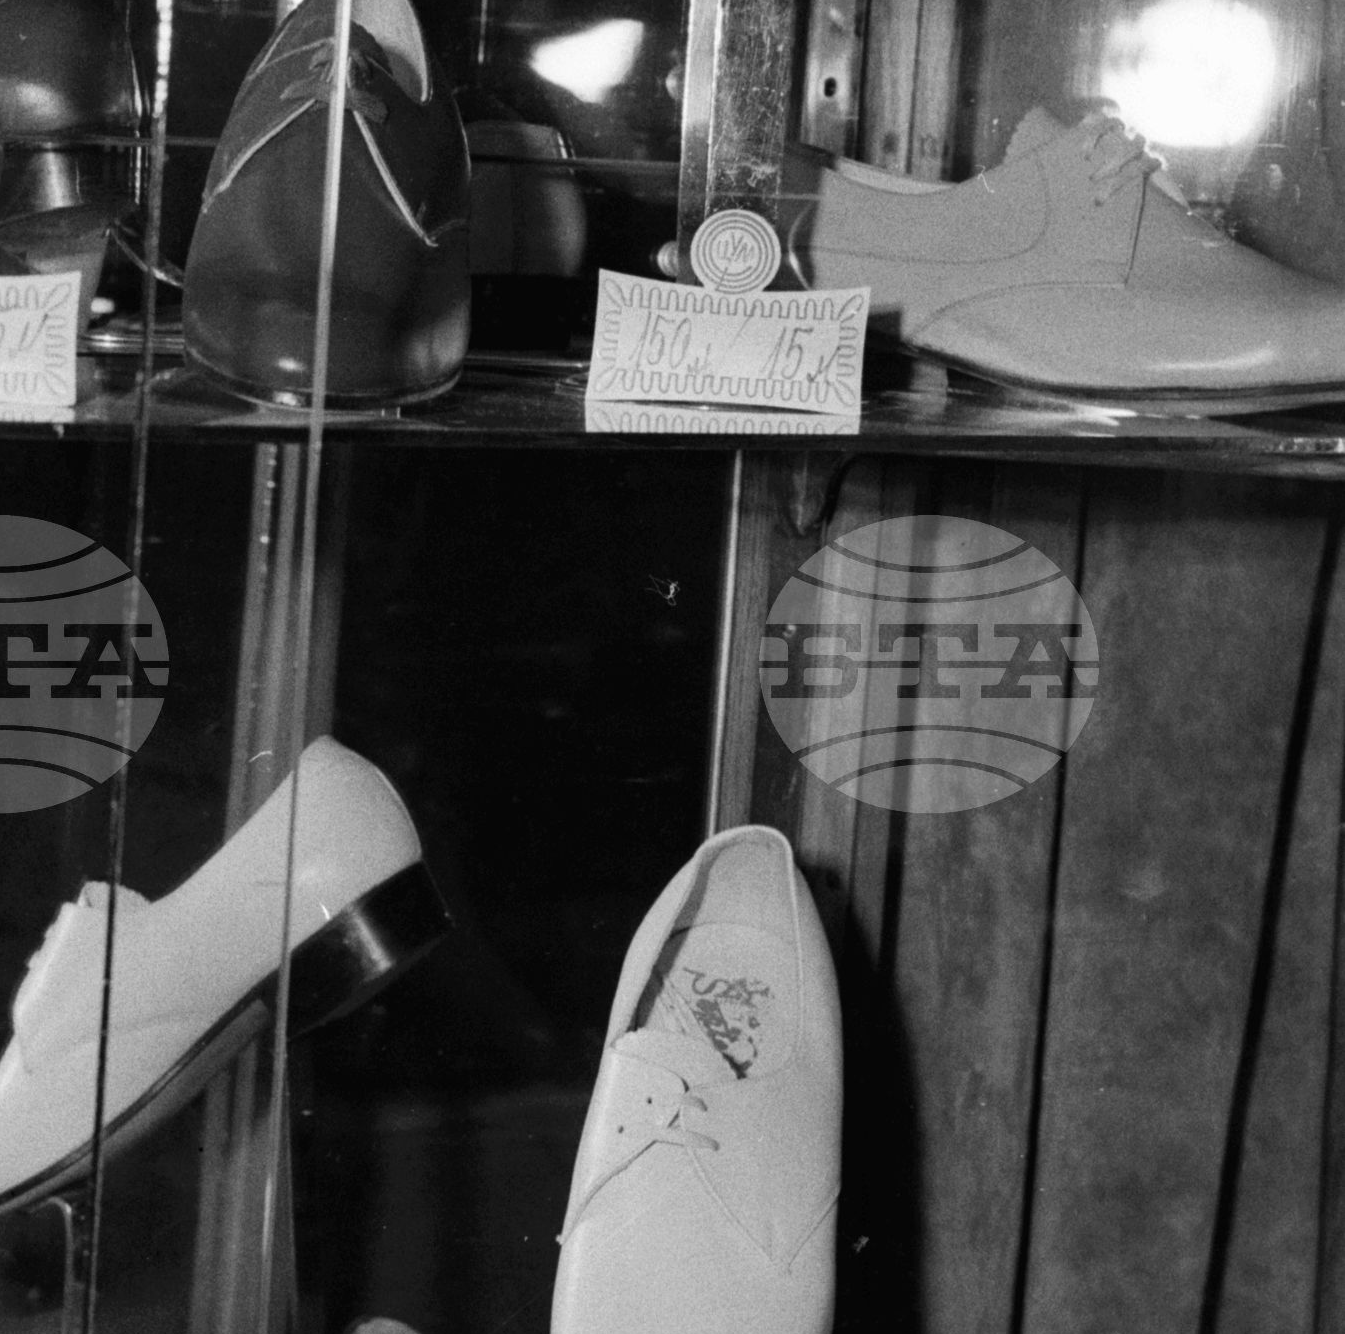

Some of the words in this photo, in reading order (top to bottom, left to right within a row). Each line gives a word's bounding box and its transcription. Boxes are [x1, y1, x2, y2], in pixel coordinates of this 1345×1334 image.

[717, 232, 754, 263] ЦУМ
[628, 310, 692, 370] 150
[761, 326, 814, 380] 15
